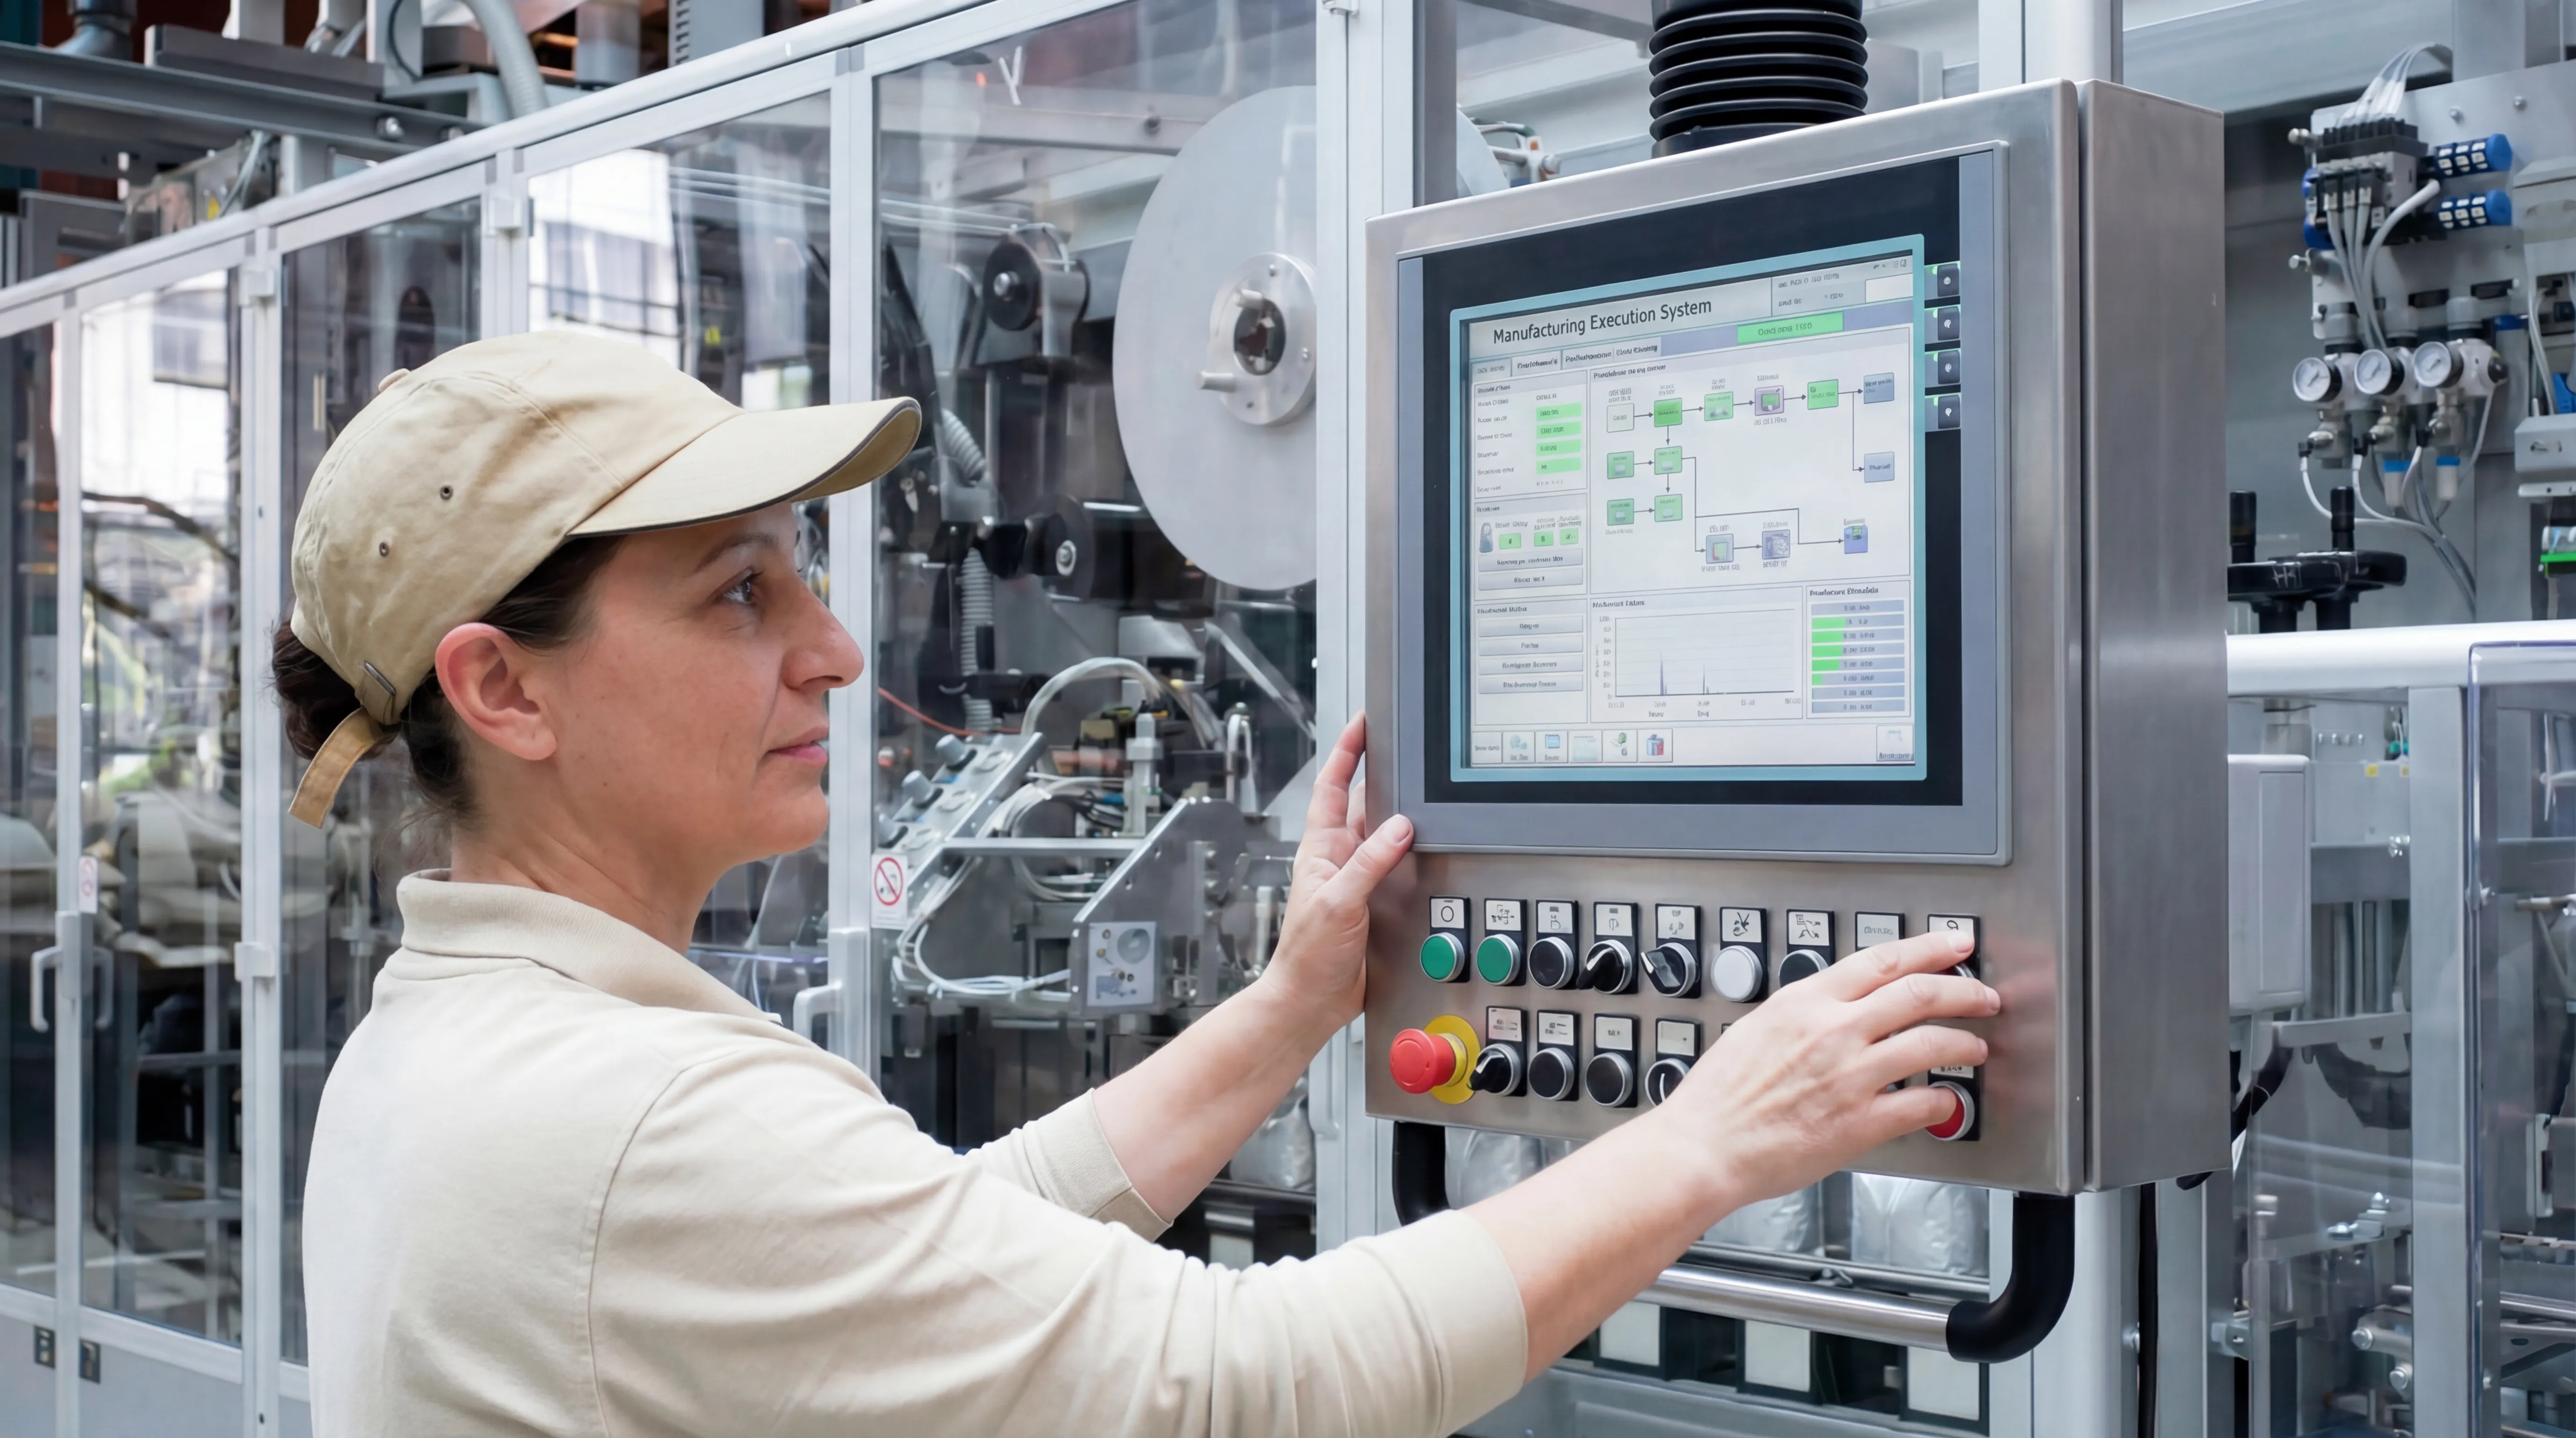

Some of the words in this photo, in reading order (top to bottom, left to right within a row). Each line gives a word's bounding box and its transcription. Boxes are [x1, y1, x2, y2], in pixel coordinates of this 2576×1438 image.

[1493, 319, 1585, 344] Manufacturing
[1590, 308, 1656, 330] Execution
[1661, 301, 1712, 322] System
